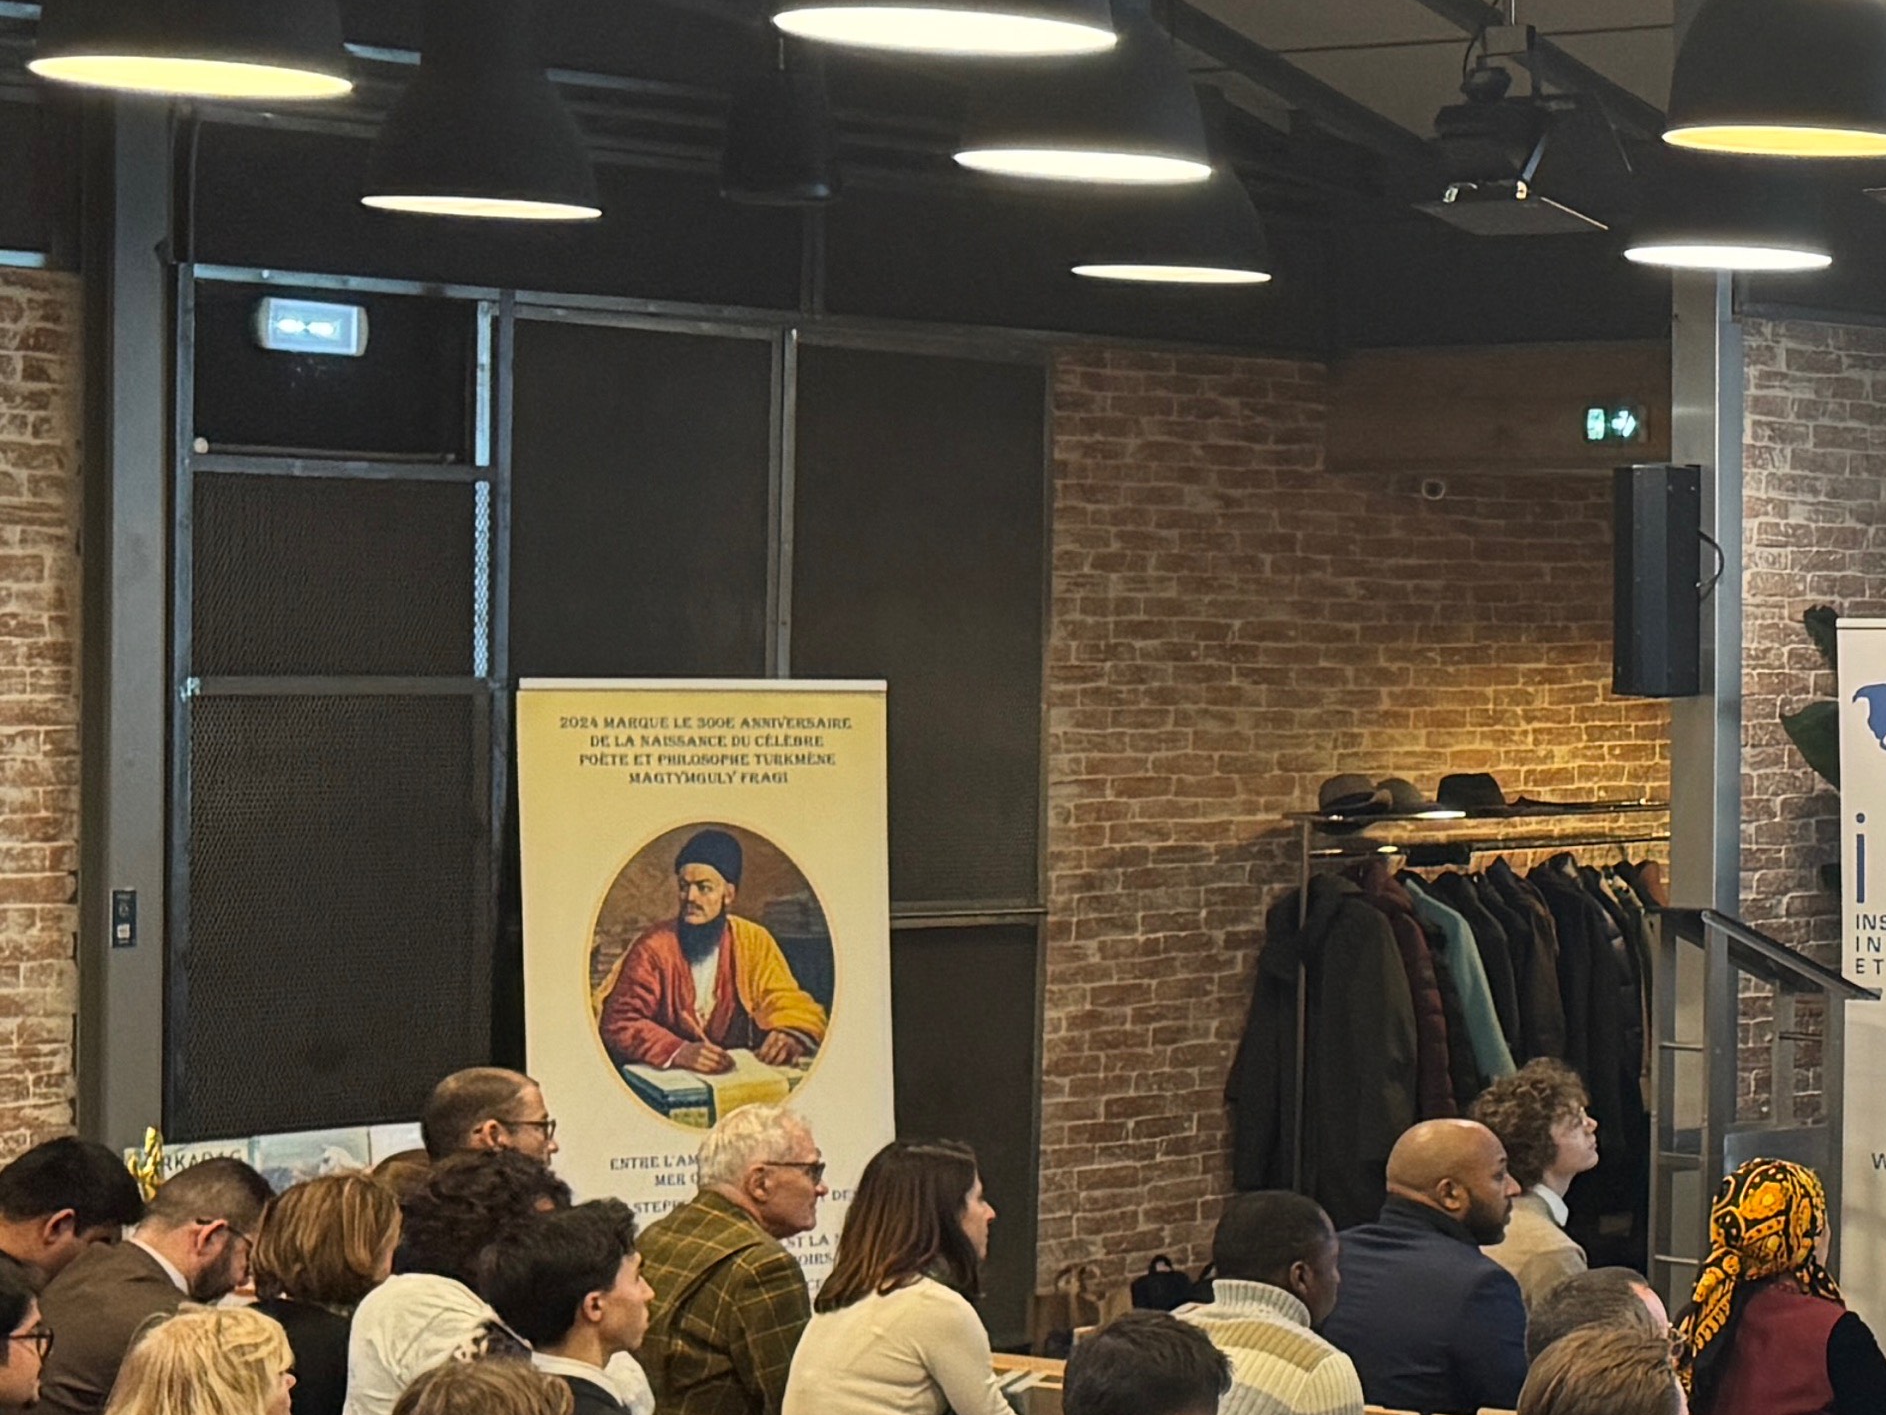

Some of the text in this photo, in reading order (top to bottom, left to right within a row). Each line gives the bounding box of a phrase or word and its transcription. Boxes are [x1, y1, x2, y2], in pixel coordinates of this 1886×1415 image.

[560, 716, 852, 730] 2024 MARQUE LE 300E ANNIVERSAIRE
[590, 735, 610, 747] DE
[615, 735, 635, 747] LA
[640, 735, 727, 748] NAISSANCE
[731, 735, 750, 748] DU
[633, 754, 653, 766] ET
[658, 754, 749, 766] PHILOSOPHE
[1856, 958, 1884, 975] ET
[610, 1155, 699, 1171] ENTRE L'AM
[655, 1174, 686, 1186] MER
